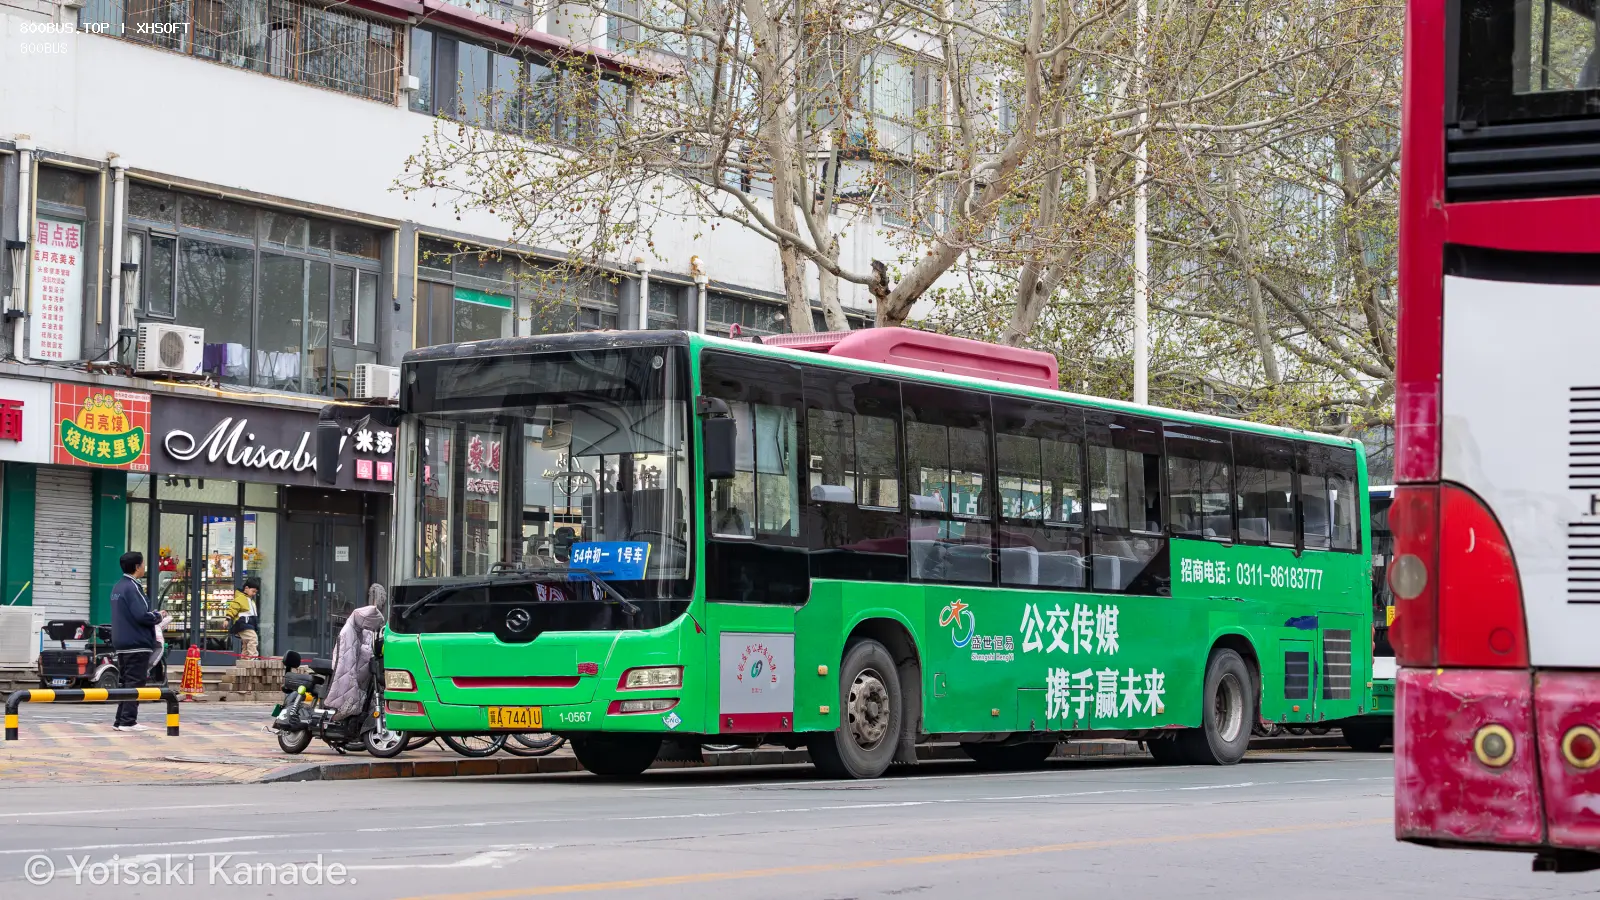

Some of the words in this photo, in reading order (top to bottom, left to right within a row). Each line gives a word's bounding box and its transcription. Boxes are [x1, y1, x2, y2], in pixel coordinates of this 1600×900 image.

[84, 413, 123, 432] 月亮馍
[65, 426, 141, 459] 烧饼夹里脊
[573, 547, 610, 564] 54中初一
[617, 547, 644, 564] 1号车
[1236, 562, 1324, 590] 0311-86183777
[1019, 602, 1120, 656] 公交传媒
[971, 635, 1014, 651] 盛世恒易
[1045, 667, 1166, 720] 携手赢未来
[559, 712, 592, 723] 1-0567
